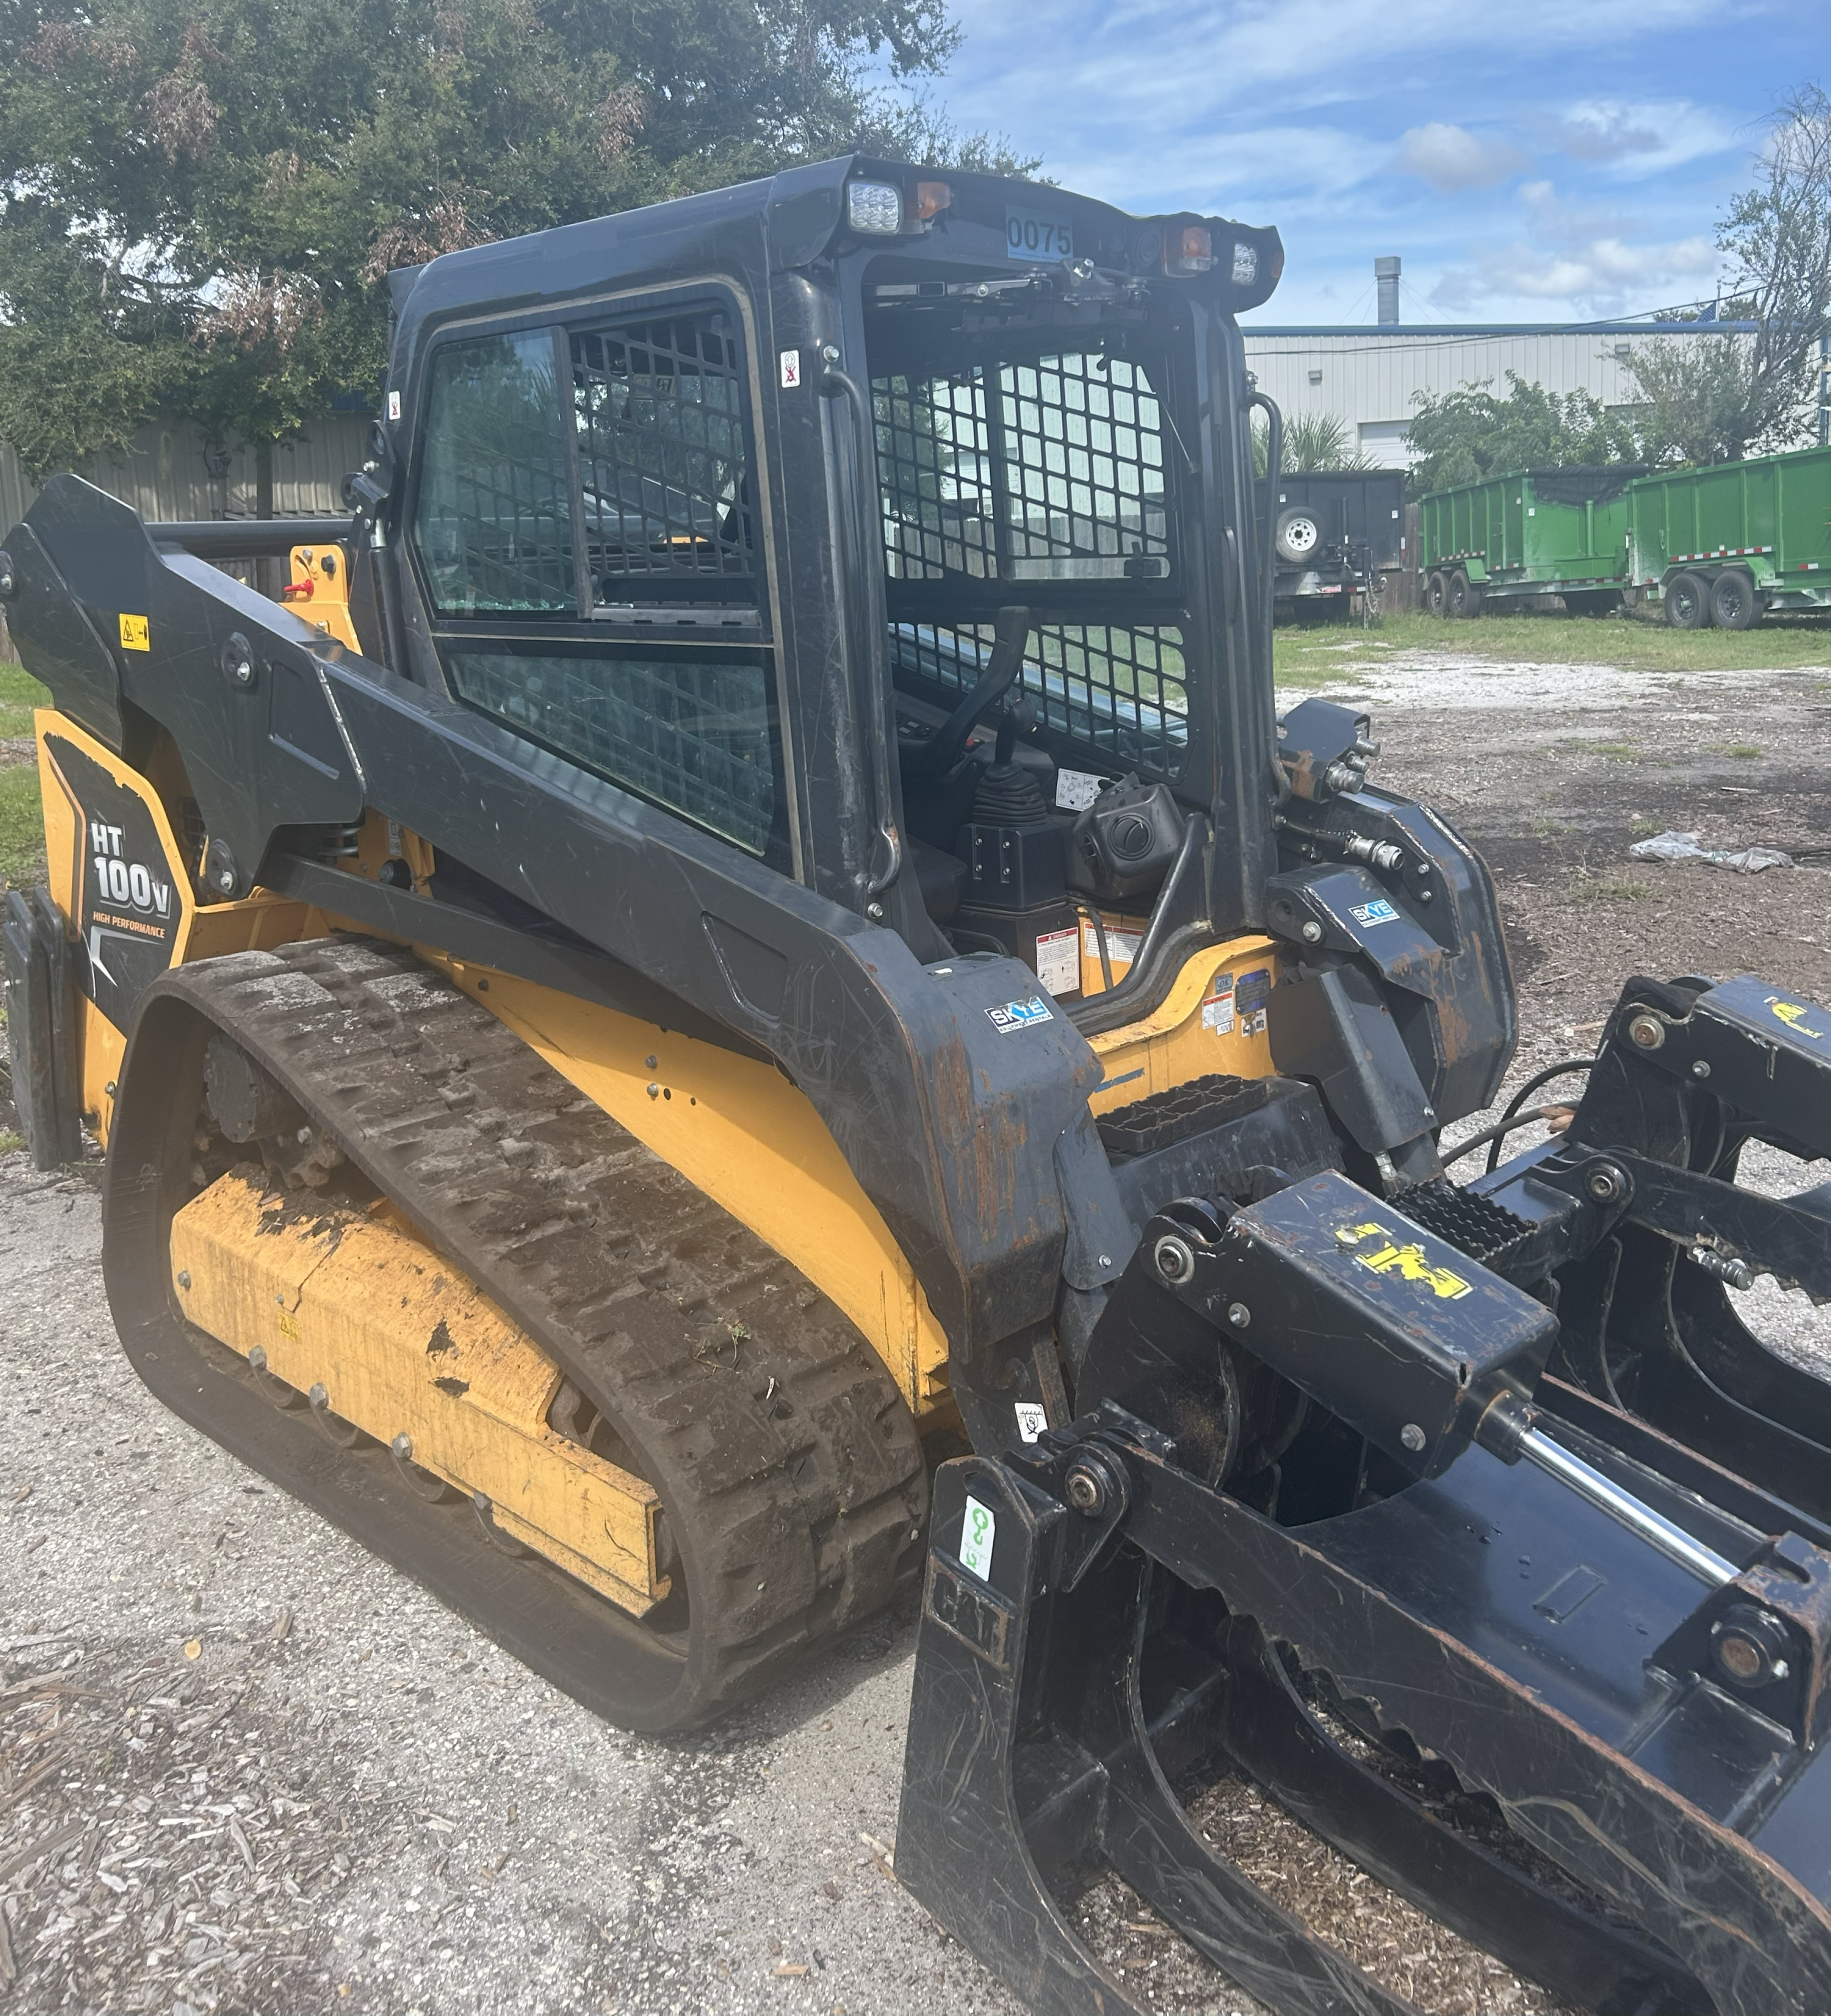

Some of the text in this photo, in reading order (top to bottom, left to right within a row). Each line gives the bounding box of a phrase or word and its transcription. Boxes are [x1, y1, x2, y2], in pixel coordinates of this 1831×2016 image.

[1007, 217, 1071, 255] 0075
[91, 823, 122, 856] HT
[93, 911, 166, 938] HIGH PERFORMANCE
[1353, 902, 1392, 920] SKYE
[990, 1000, 1045, 1024] SKYE
